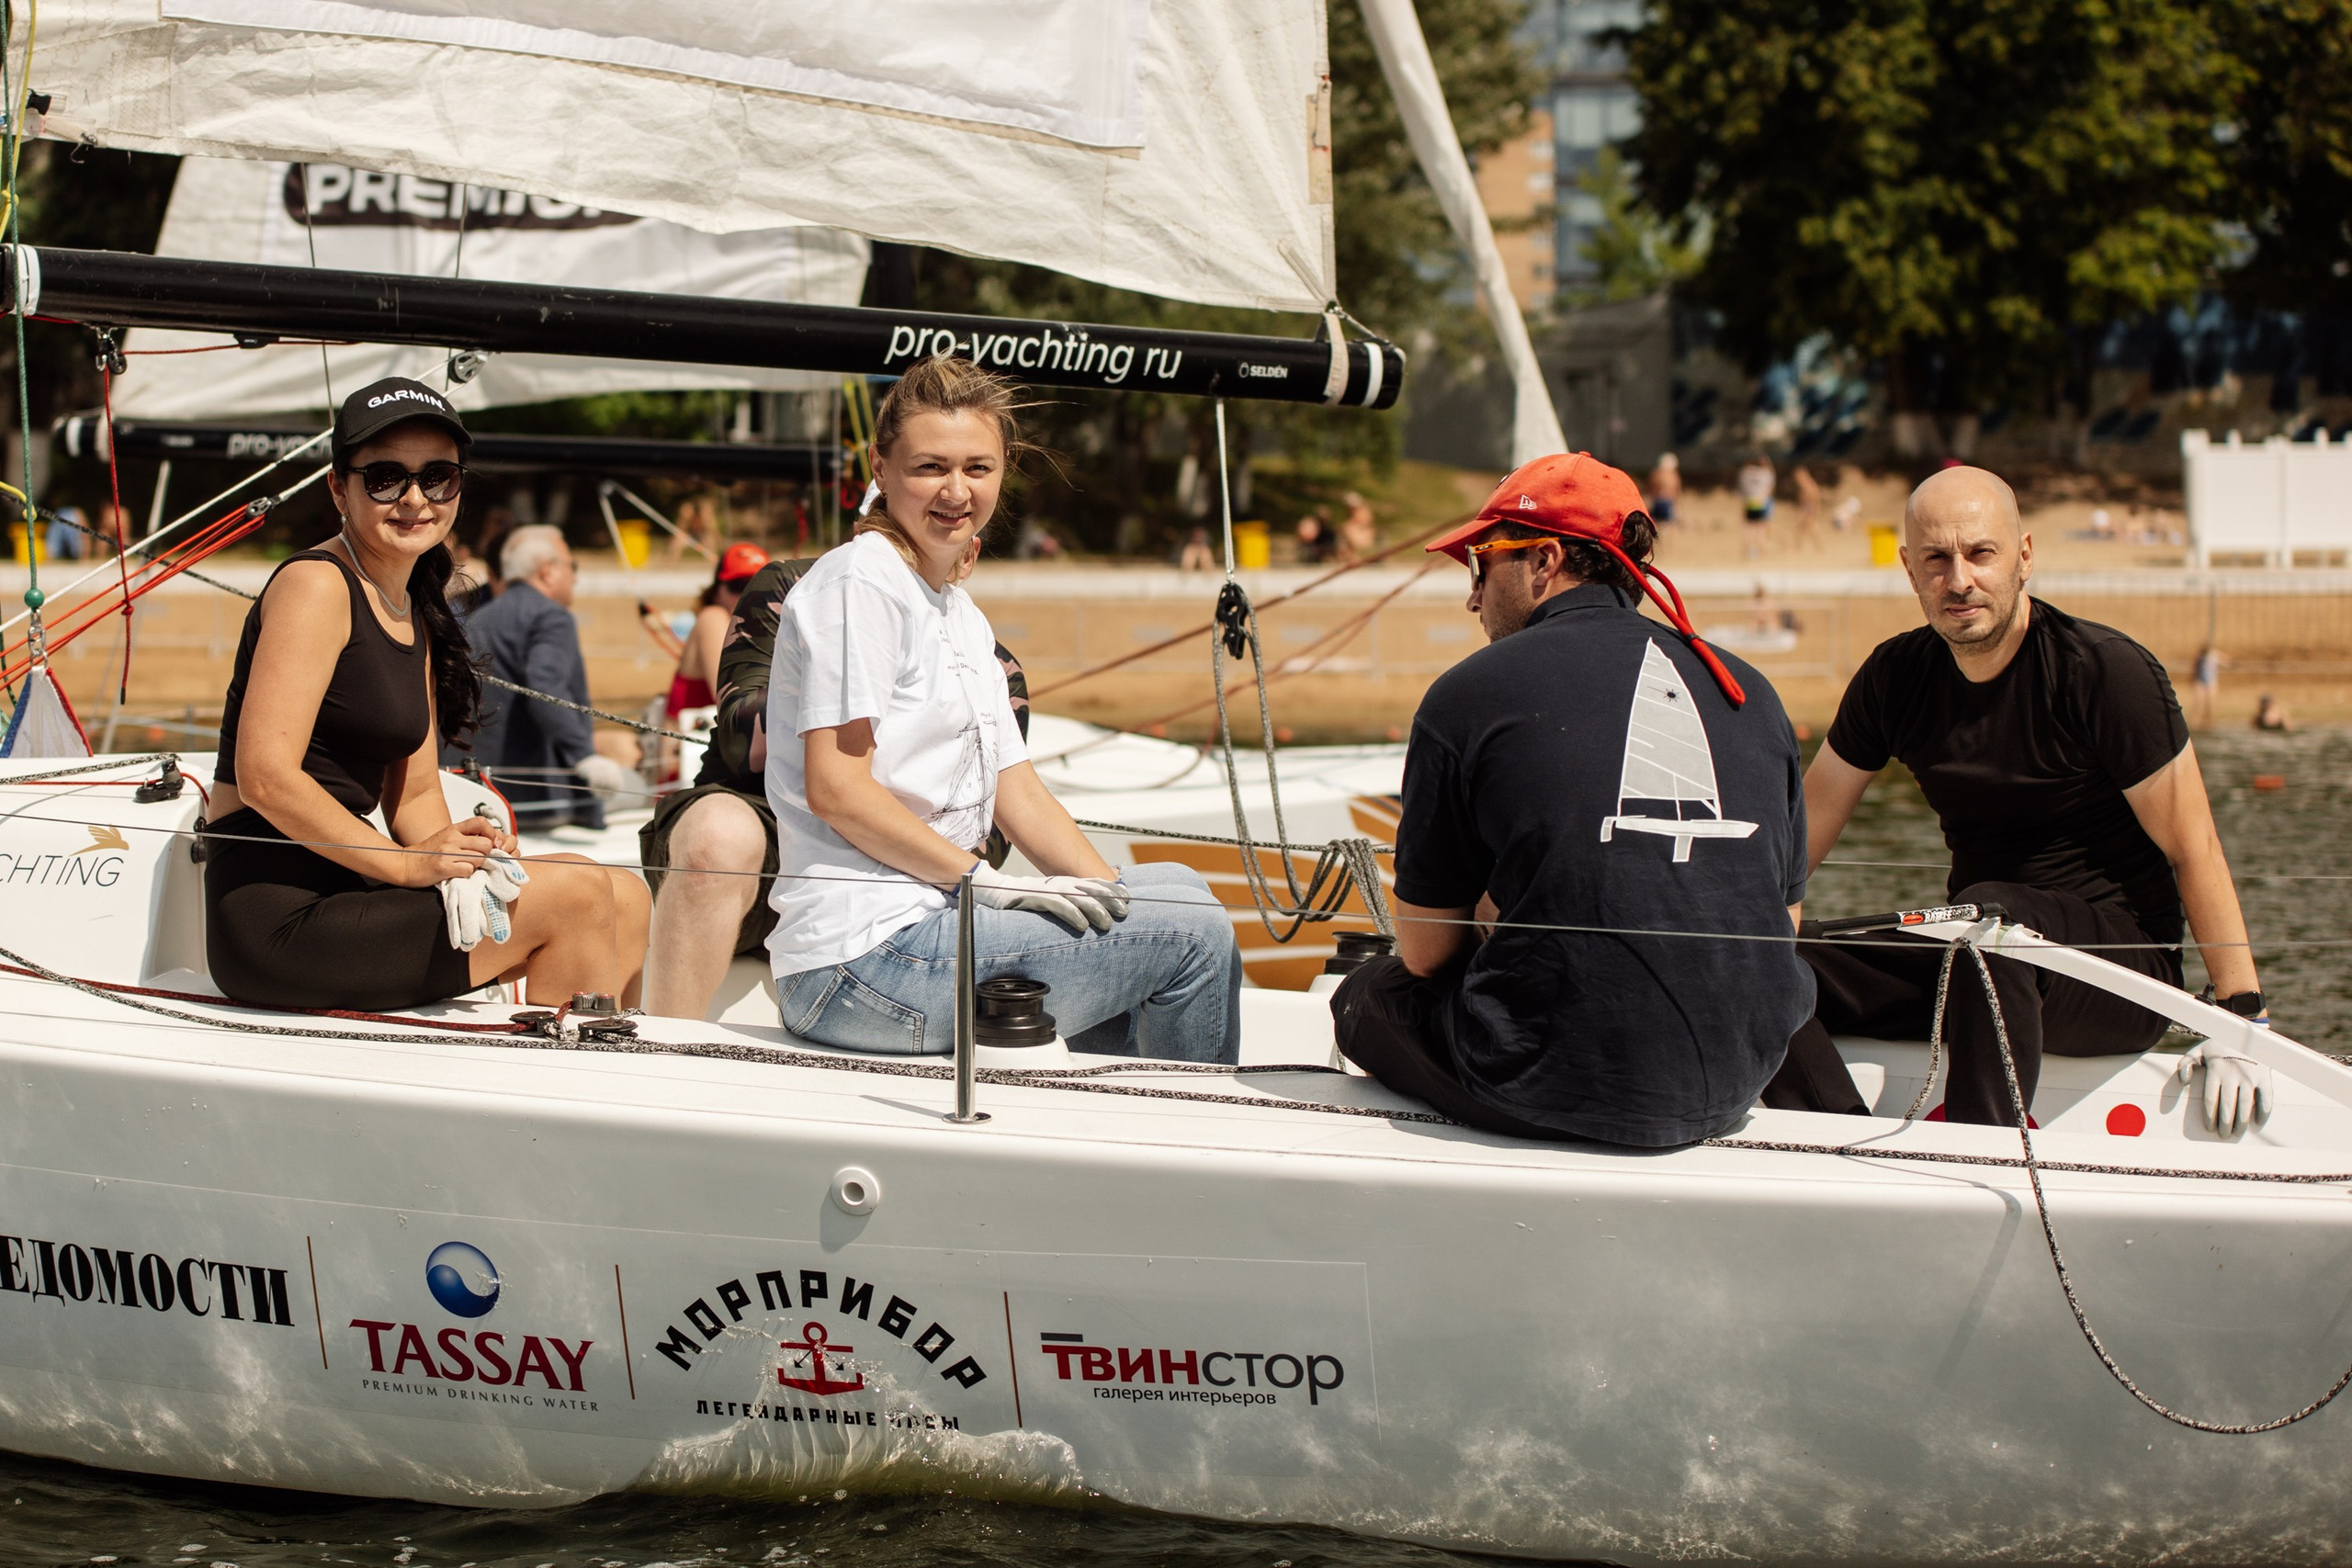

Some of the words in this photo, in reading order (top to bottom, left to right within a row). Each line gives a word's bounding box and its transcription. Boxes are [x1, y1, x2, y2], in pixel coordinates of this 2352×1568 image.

[884, 325, 1135, 384] pro-yachting
[1144, 347, 1182, 378] ru
[0, 1235, 295, 1326] ЕДОМОСТИ
[348, 1319, 594, 1392] TASSAY
[655, 1269, 987, 1389] МОРПРИБОР
[363, 1379, 438, 1396] PREMIUM
[447, 1388, 533, 1405] DRINKING
[543, 1397, 599, 1412] WATER
[1093, 1387, 1163, 1403] галерея
[1169, 1391, 1276, 1406] интерьеров
